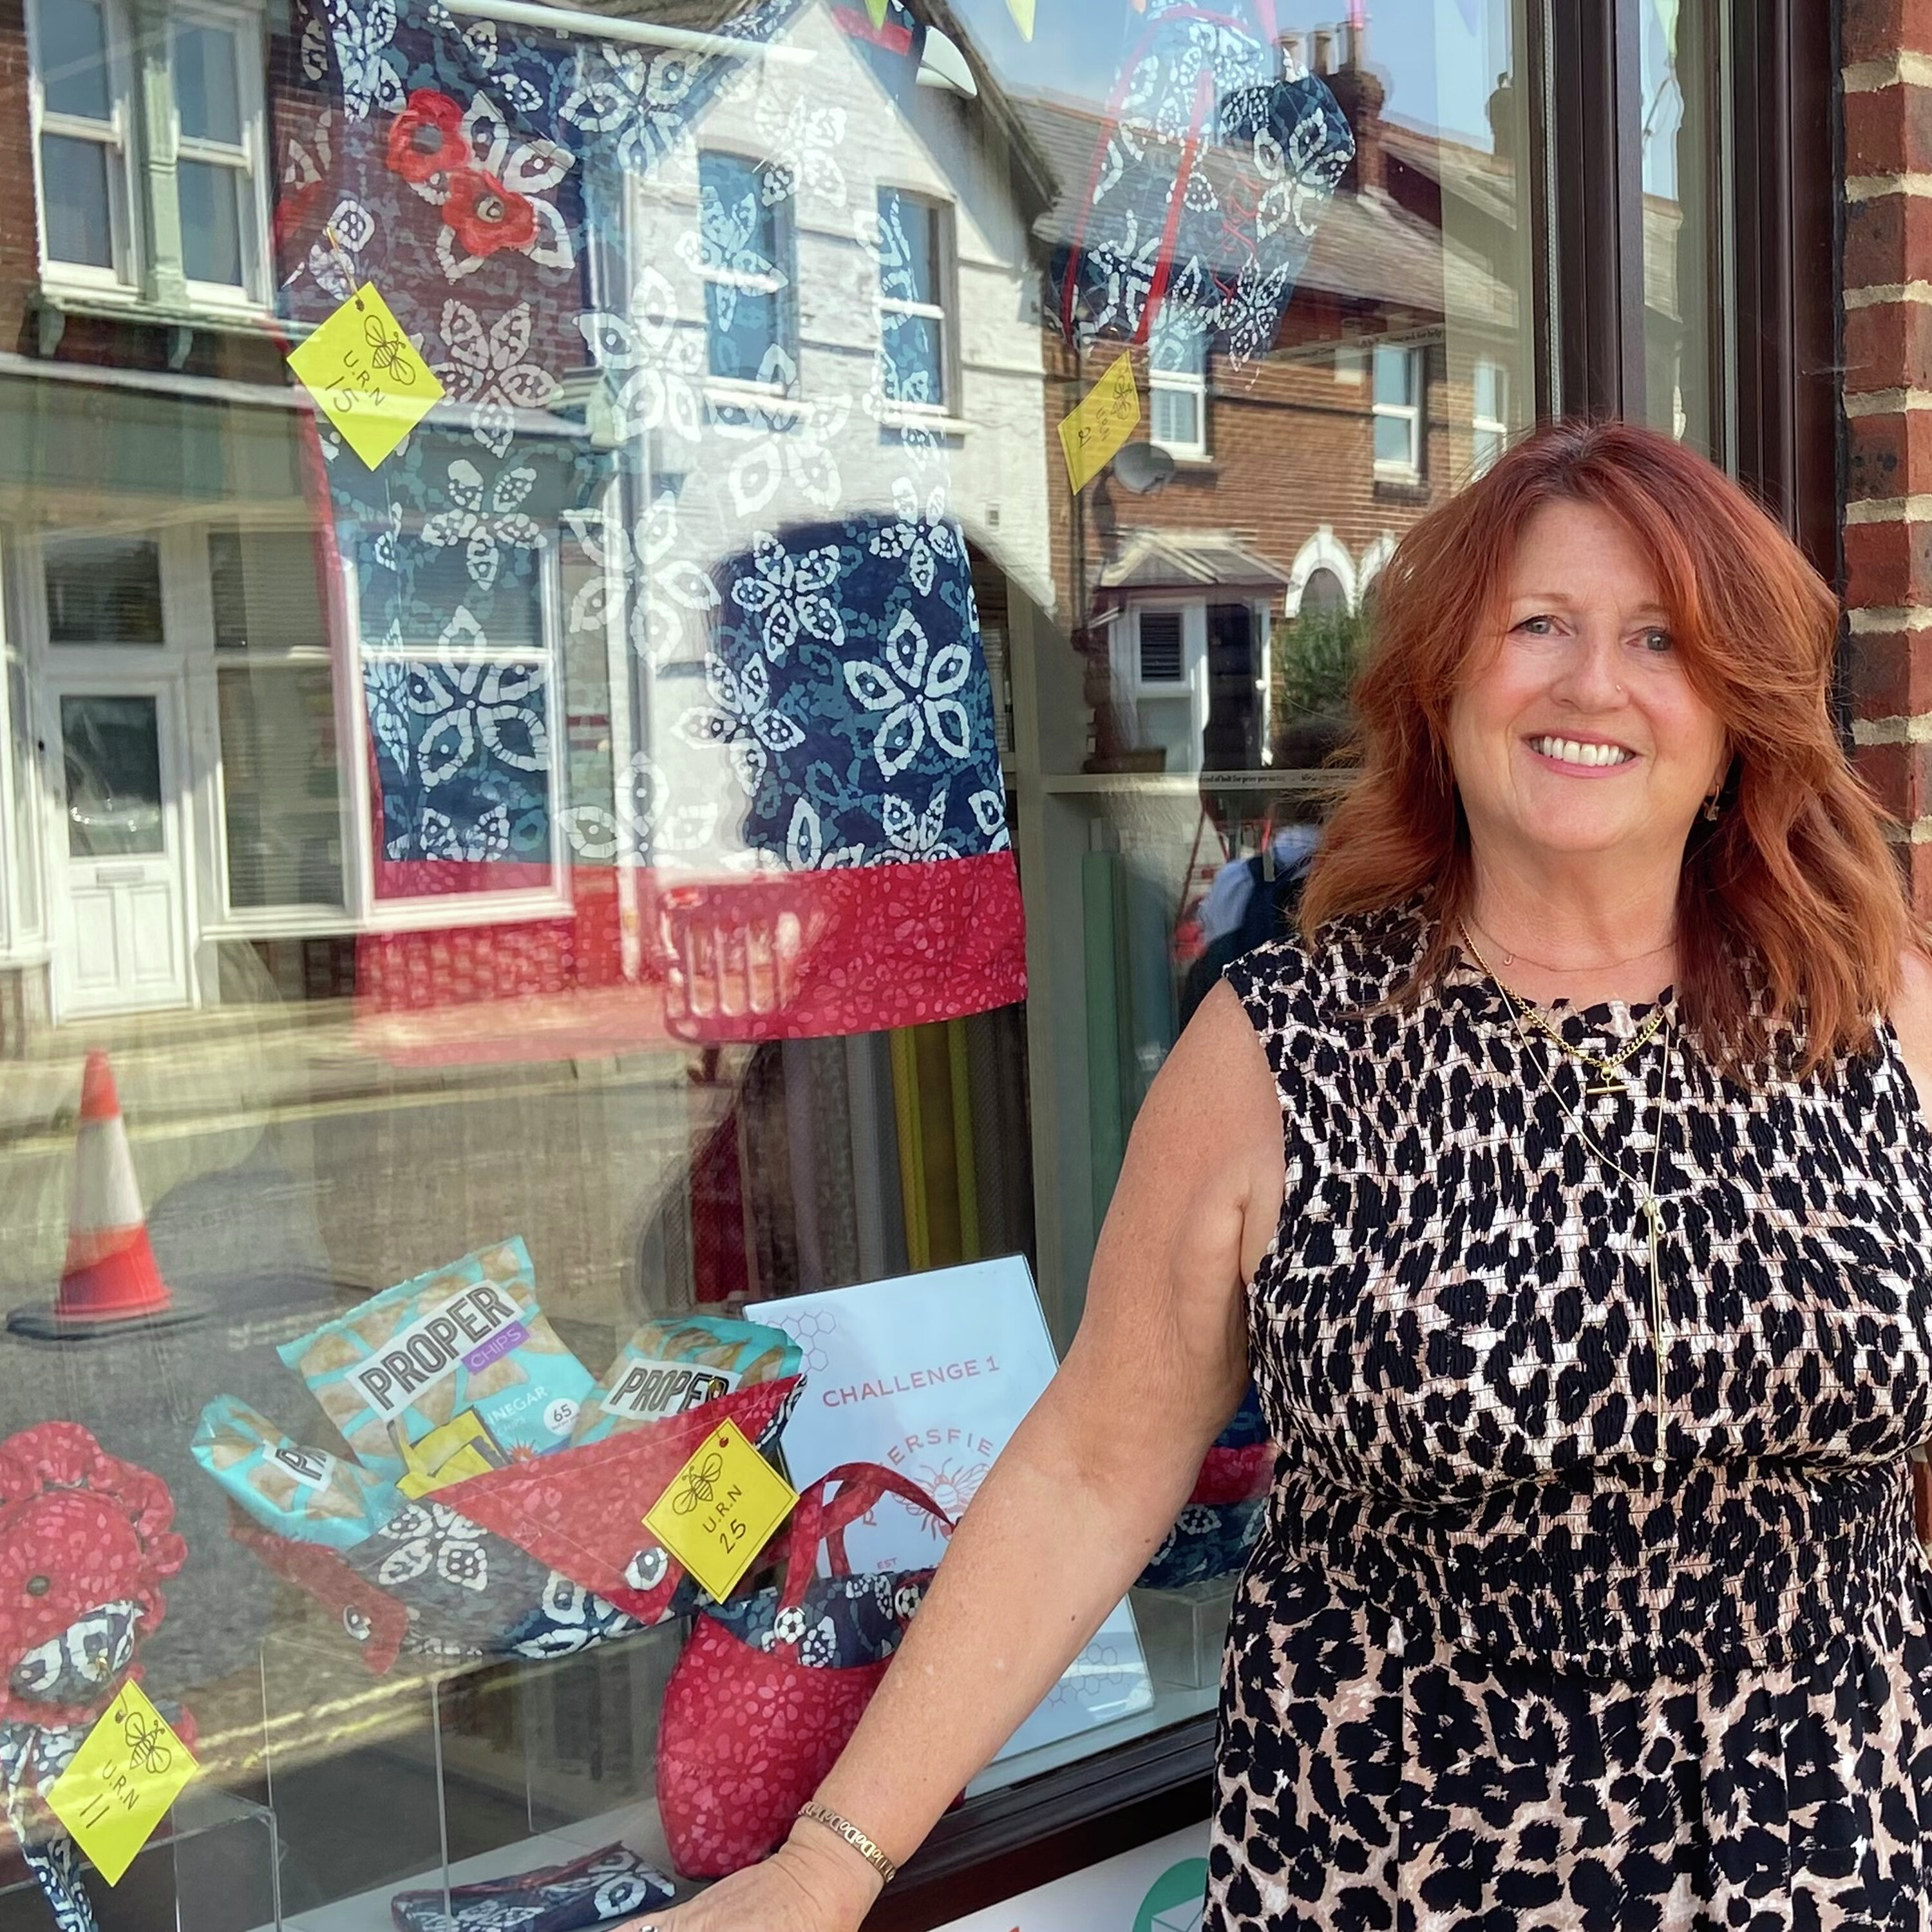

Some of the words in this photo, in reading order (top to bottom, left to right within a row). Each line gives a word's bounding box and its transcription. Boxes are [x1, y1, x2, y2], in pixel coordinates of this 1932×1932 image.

[325, 375, 359, 413] 15
[343, 350, 386, 406] U.R.N
[358, 1286, 515, 1410] PROPER
[471, 1329, 522, 1369] CHIPS
[823, 1359, 980, 1407] CHALLENGE
[987, 1356, 1000, 1372] 1
[487, 1385, 547, 1426] INEGAR
[553, 1403, 572, 1423] 65
[702, 1484, 743, 1533] U.R.N
[719, 1518, 746, 1554] 25
[876, 1557, 897, 1570] EST
[102, 1759, 140, 1811] U.R.N
